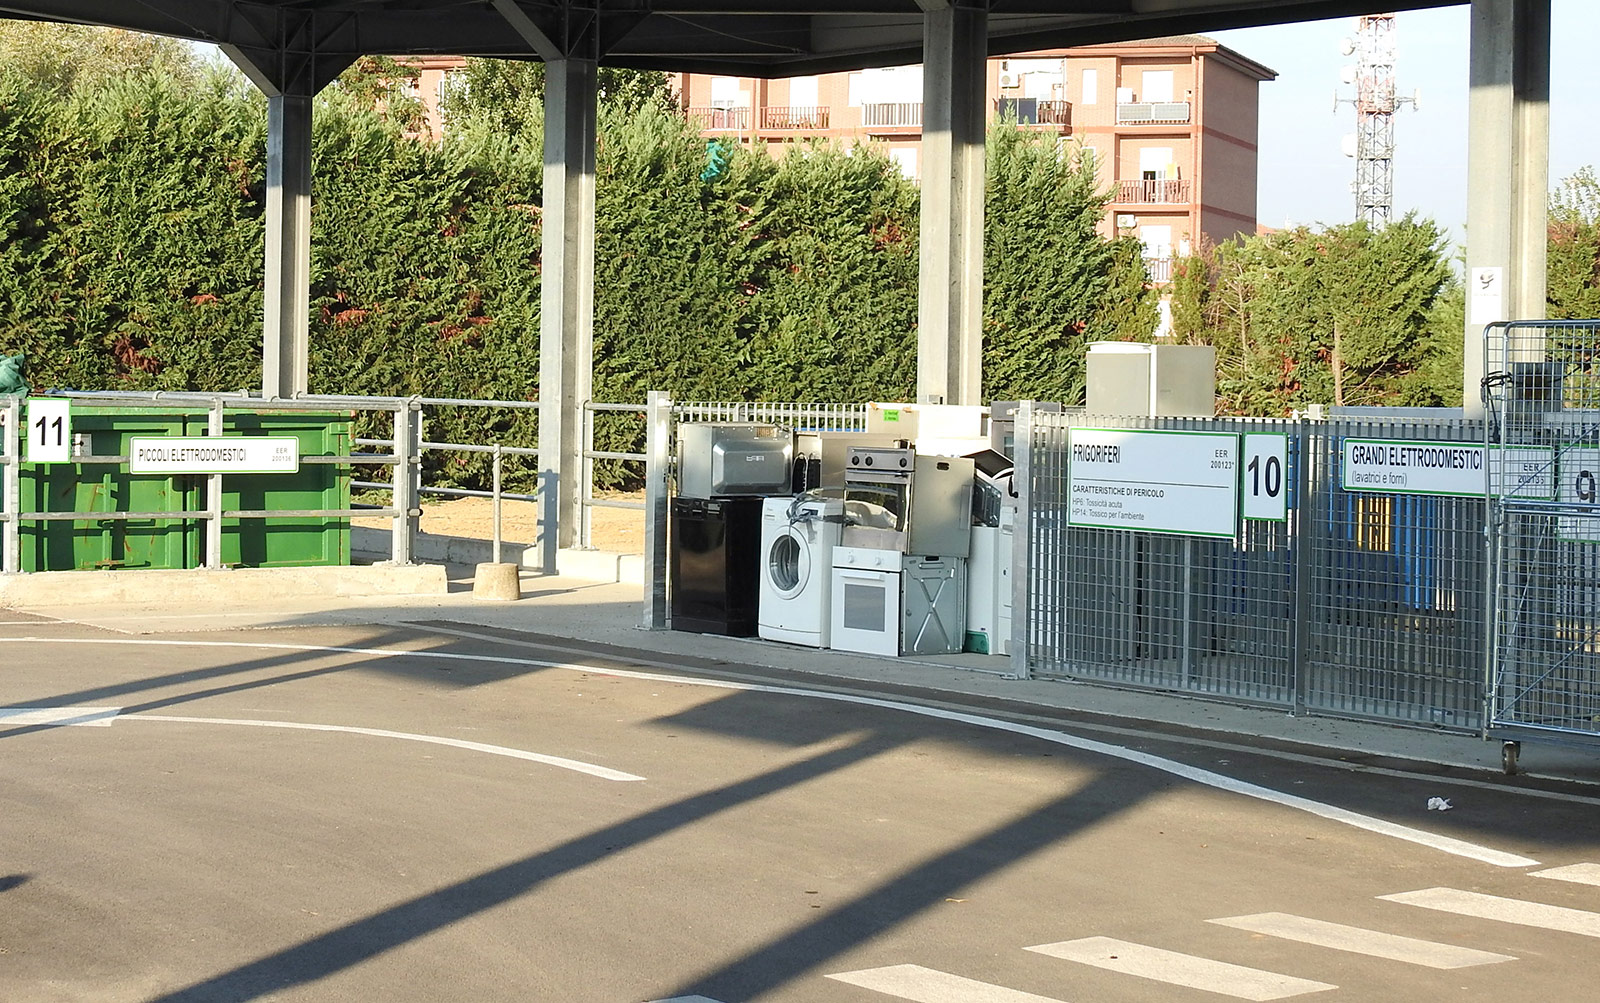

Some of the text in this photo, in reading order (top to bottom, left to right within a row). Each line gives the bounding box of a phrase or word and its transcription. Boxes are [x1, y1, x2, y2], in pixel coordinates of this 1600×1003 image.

[36, 416, 62, 446] 11
[139, 448, 247, 461] PICCOLI ELETTRODOMESTICI
[1073, 444, 1120, 463] FRIGORIFERI
[1215, 449, 1228, 458] EER
[1352, 445, 1482, 470] GRANDI ELETTRODOMESTICI
[1523, 463, 1539, 472] EER
[1247, 455, 1281, 497] 10
[1351, 470, 1408, 487] (lavatrici e forni)
[1072, 485, 1165, 498] CARATTERISTICHE DI PERICOLO
[1576, 470, 1596, 513] 9
[1072, 498, 1122, 509] HP6: Tossicità acuta
[1072, 508, 1145, 521] HP14: Tossico per l'ambiente
